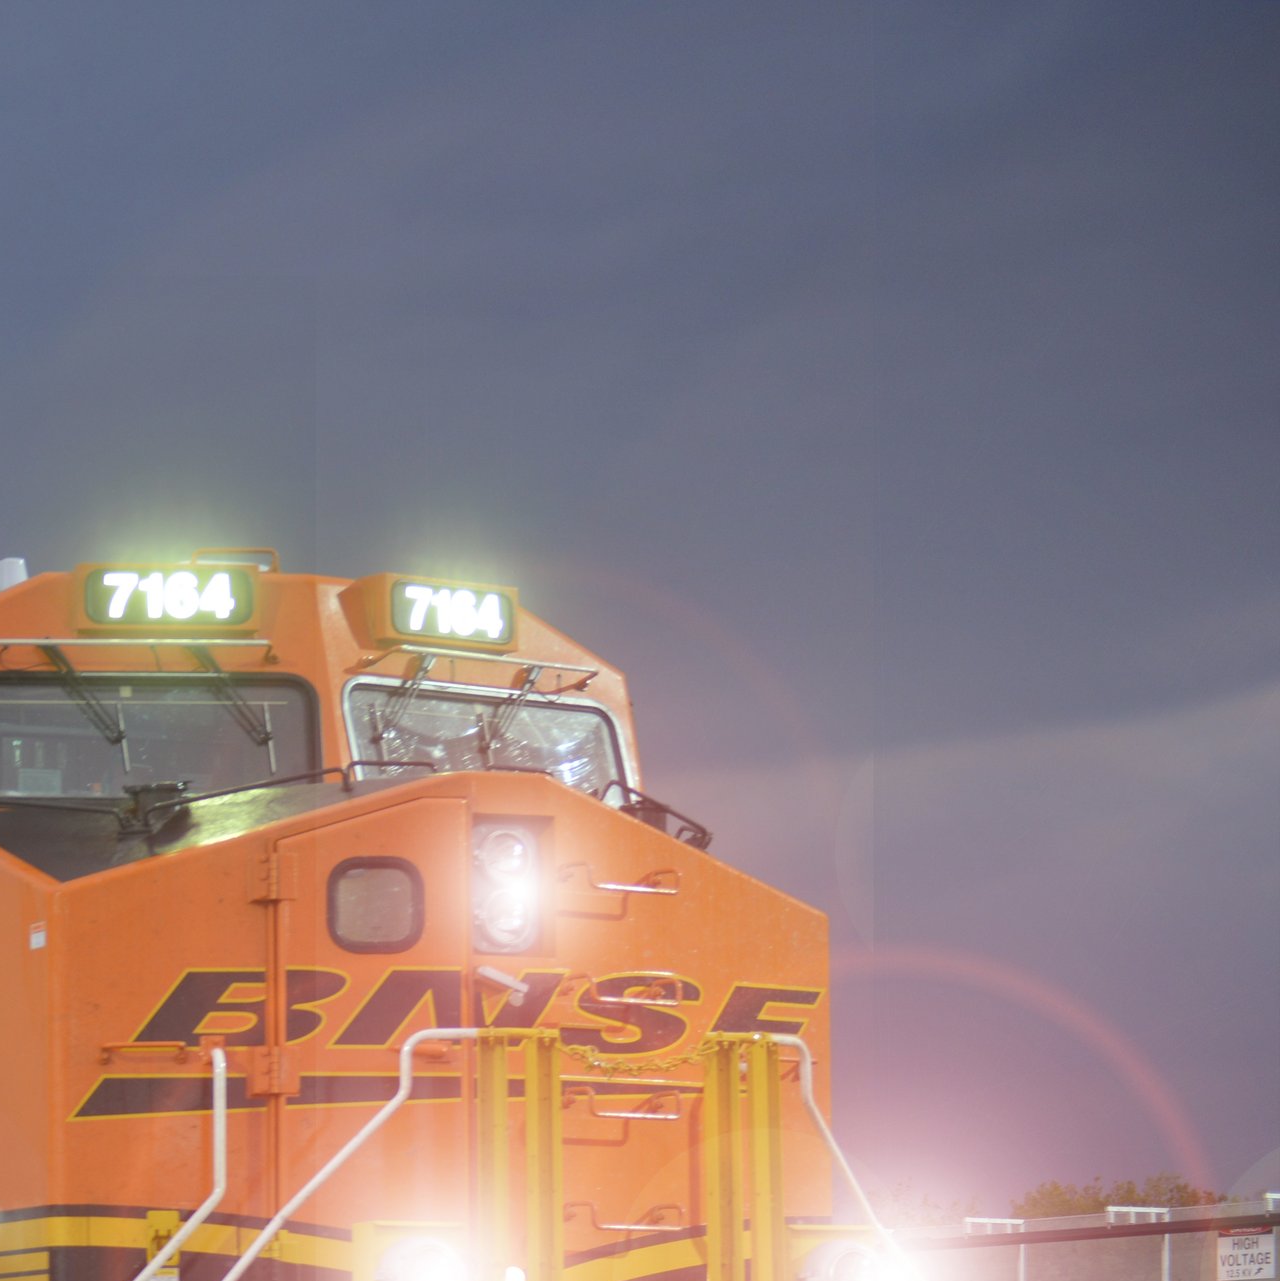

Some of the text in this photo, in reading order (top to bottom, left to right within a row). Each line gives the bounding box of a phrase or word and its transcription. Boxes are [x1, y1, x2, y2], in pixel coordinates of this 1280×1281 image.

[103, 572, 235, 619] 7164
[404, 585, 504, 639] 7164
[129, 966, 824, 1056] BNSF
[1220, 1252, 1271, 1266] VOLTAGE
[1232, 1237, 1259, 1250] HIGH
